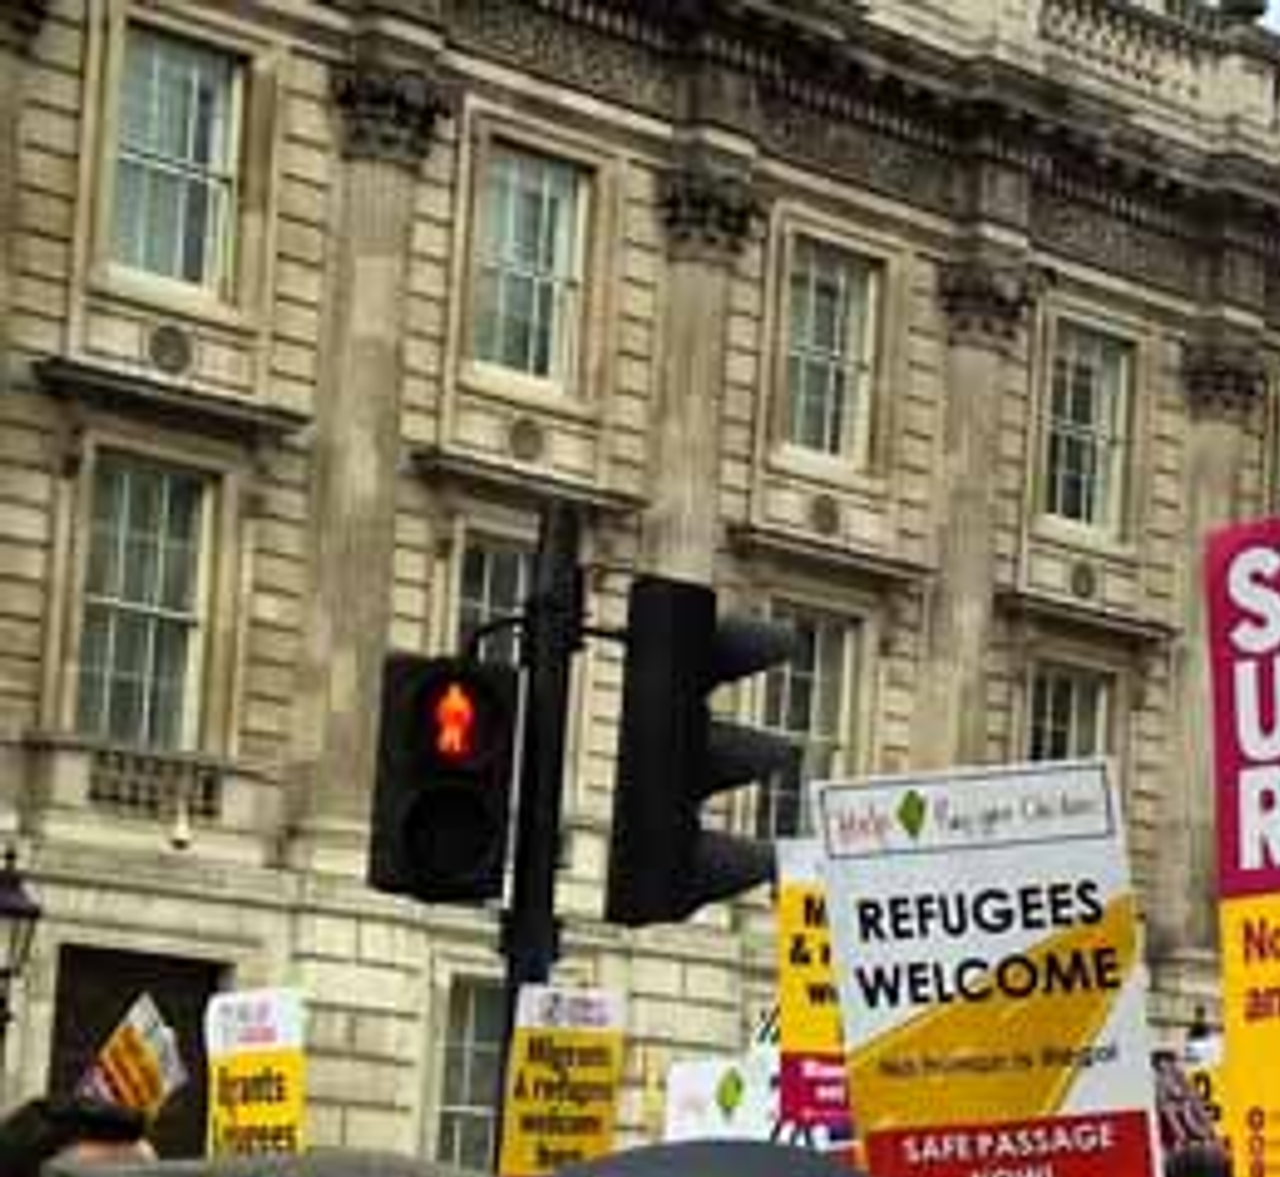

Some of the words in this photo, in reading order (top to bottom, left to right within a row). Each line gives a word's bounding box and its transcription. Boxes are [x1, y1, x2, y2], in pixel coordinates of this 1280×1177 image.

[856, 879, 1104, 943] REFUGEES
[855, 947, 1121, 1010] WELCOME
[904, 1131, 971, 1164] SAFE
[977, 1122, 1114, 1156] PASSAGE
